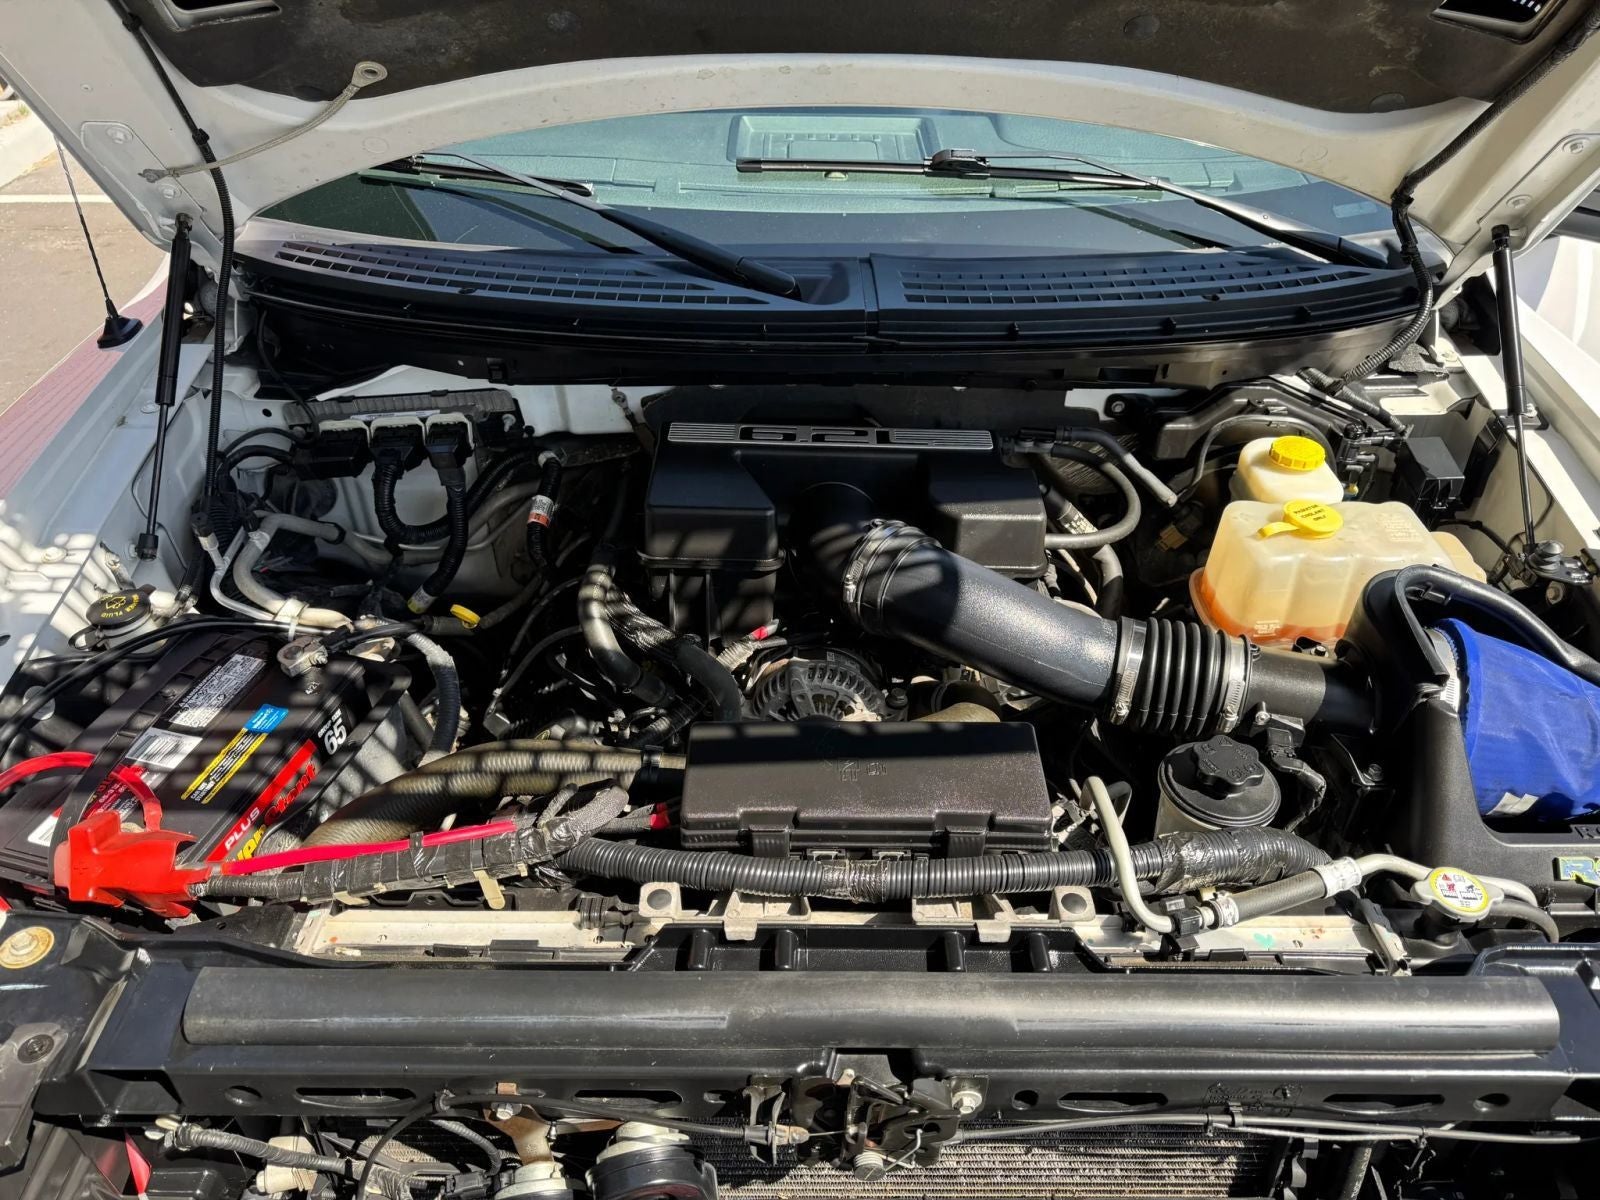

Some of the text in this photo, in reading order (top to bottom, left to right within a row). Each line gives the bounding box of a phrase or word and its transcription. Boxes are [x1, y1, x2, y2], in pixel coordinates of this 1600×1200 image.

[739, 426, 930, 445] 6.2L
[324, 717, 347, 755] 65
[224, 806, 260, 851] PLUS
